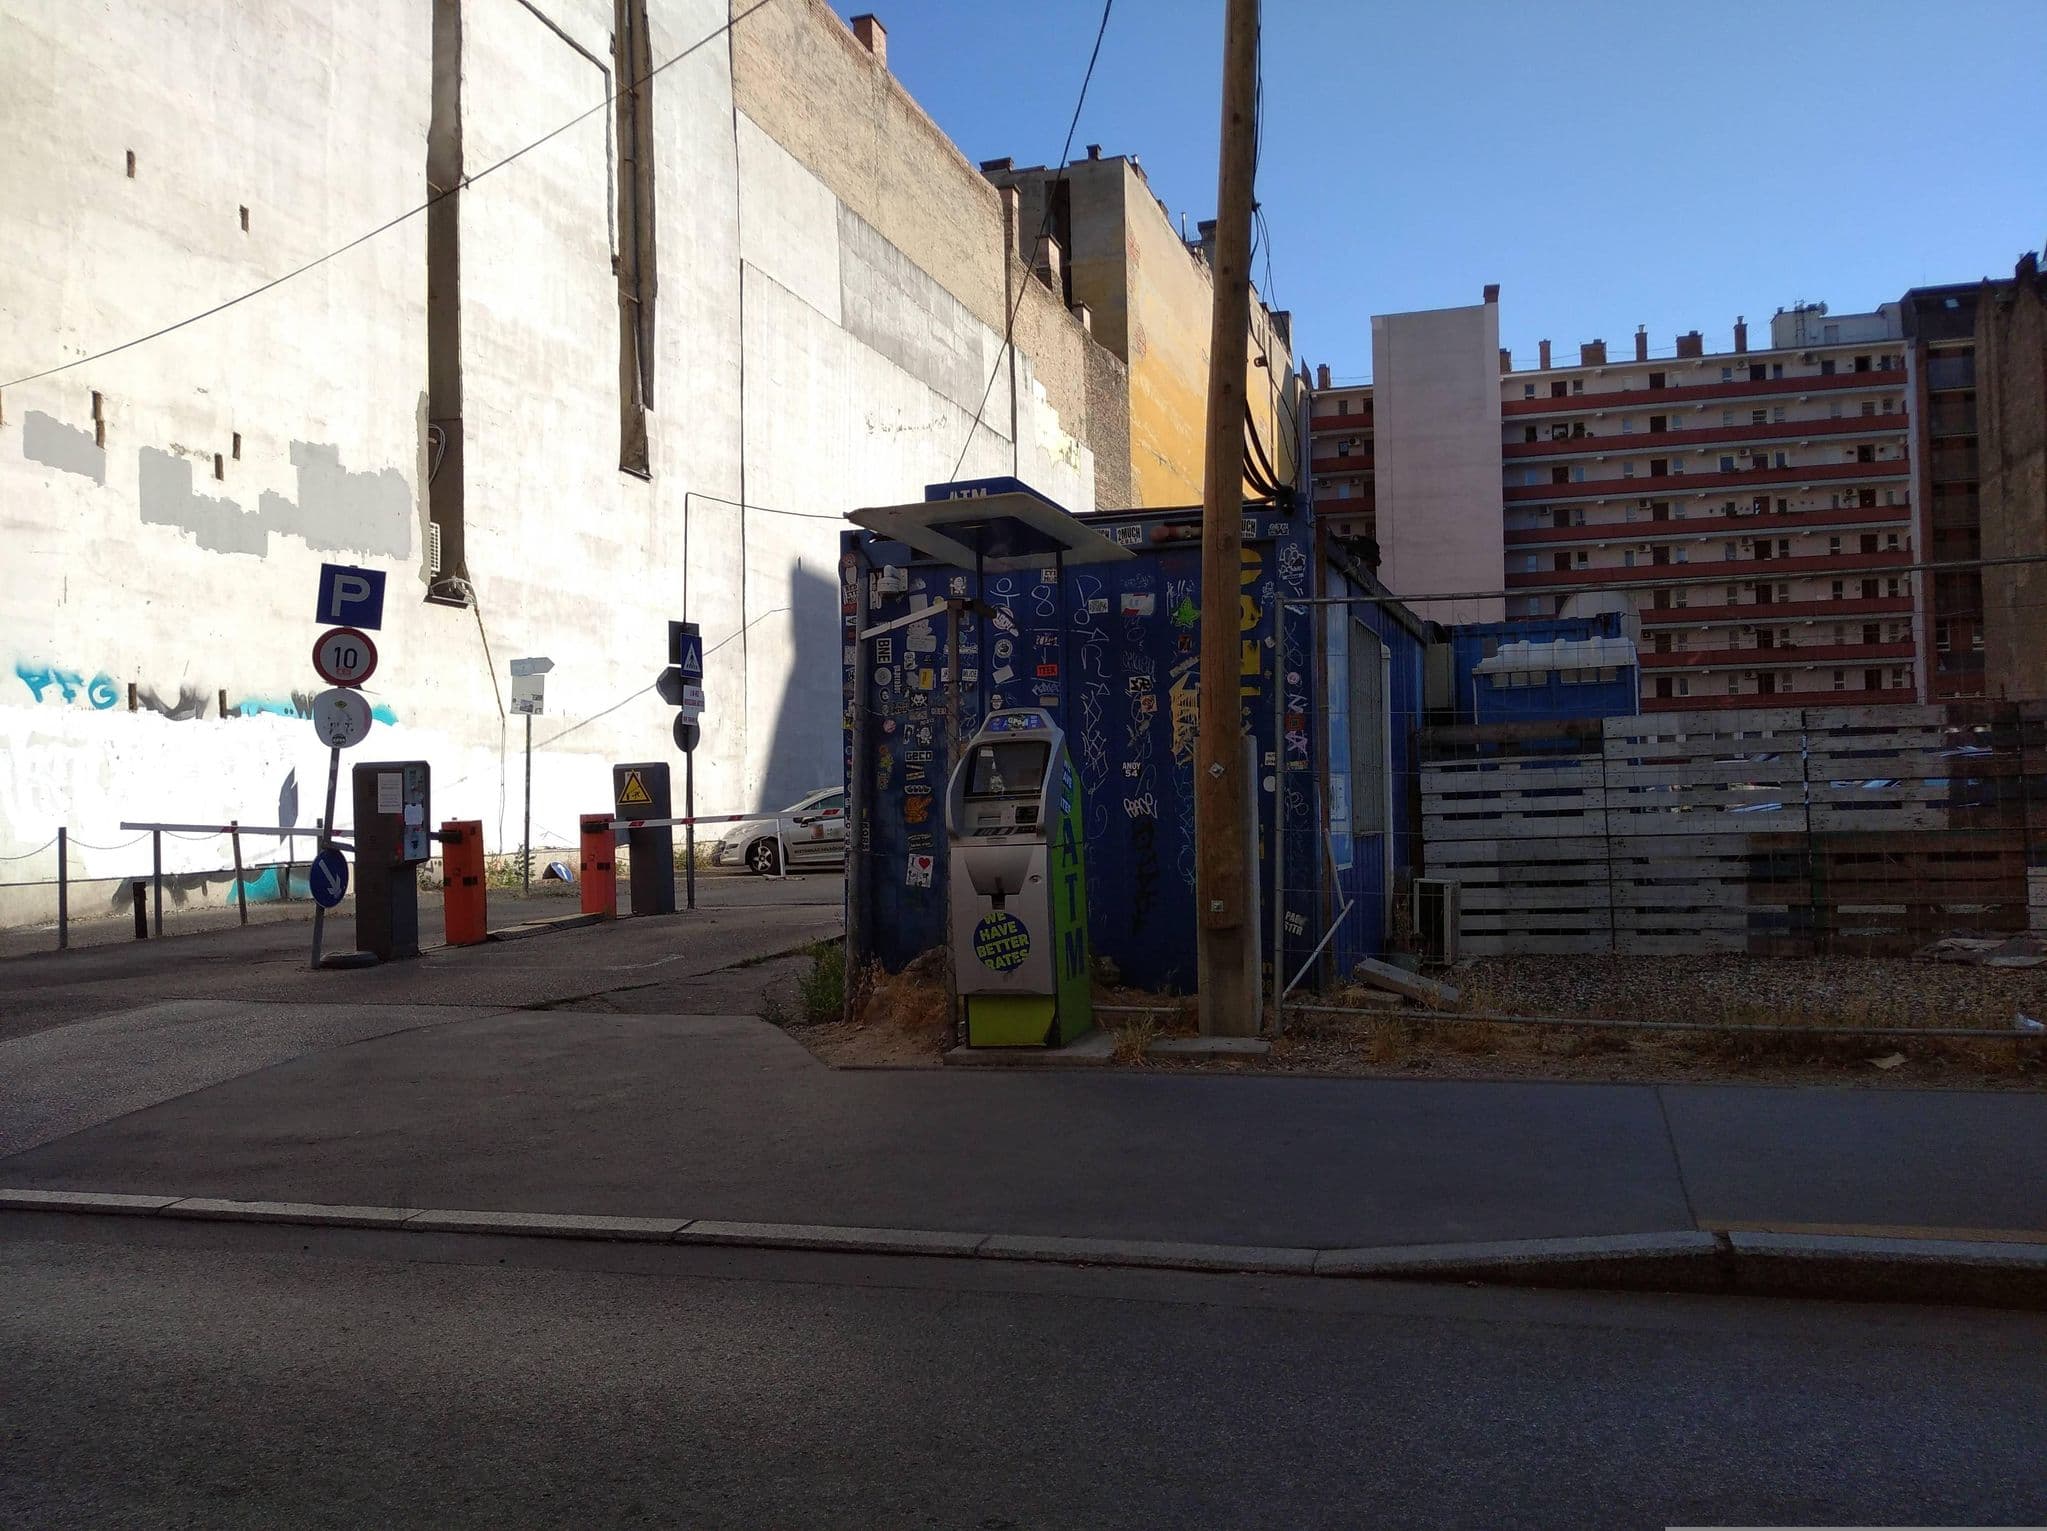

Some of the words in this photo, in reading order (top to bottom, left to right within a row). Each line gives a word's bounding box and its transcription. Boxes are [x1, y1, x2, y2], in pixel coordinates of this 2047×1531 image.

[1118, 527, 1140, 540] 2MUCH
[331, 574, 370, 617] P
[334, 646, 358, 670] 10
[878, 639, 890, 663] BNE
[980, 921, 1018, 941] HAVE
[976, 934, 1030, 958] BETTER
[984, 949, 1030, 969] RATES
